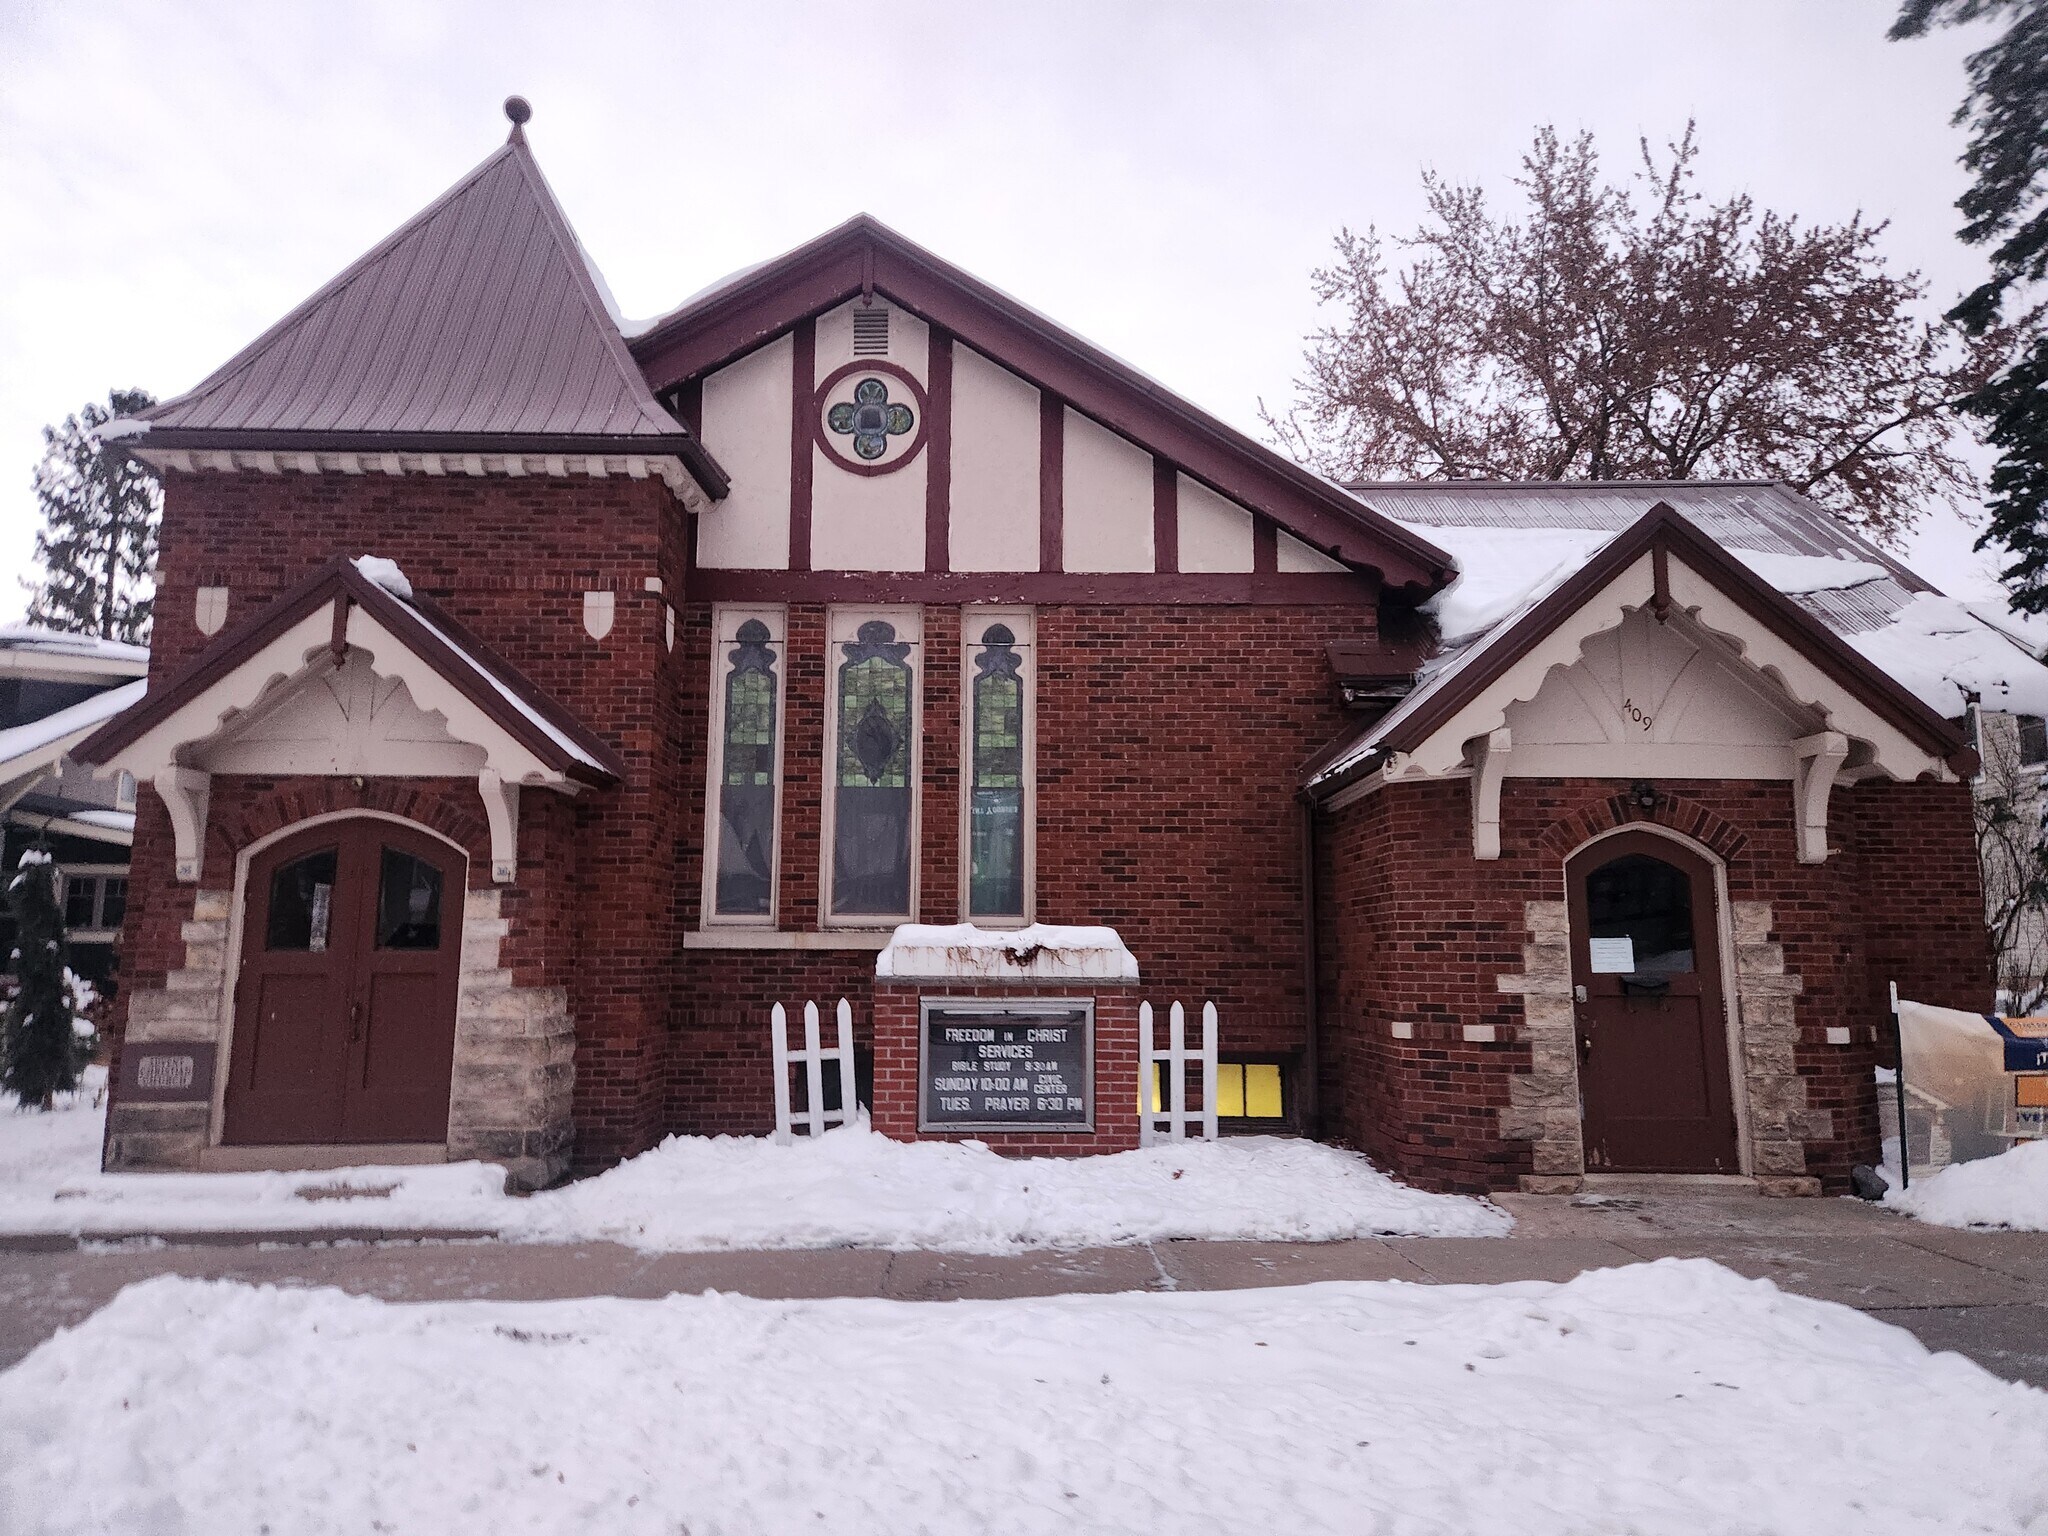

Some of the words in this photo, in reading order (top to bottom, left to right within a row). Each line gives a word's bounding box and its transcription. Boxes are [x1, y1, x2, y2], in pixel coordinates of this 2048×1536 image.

[1623, 698, 1653, 732] 409
[945, 1028, 995, 1042] FREEDOM
[1003, 1032, 1014, 1042] IN
[1027, 1028, 1068, 1043] CHRIST
[978, 1045, 1034, 1058] SERVICES
[951, 1061, 978, 1072] BIBLE
[983, 1061, 1011, 1072] STUDY
[934, 1077, 979, 1091] SUNDAY
[1012, 1077, 1029, 1091] AM
[1038, 1075, 1063, 1085] CIVIC
[1033, 1084, 1068, 1095] CENTER
[984, 1097, 1031, 1111] PRAYER
[1036, 1097, 1063, 1111] 6:30
[1066, 1097, 1083, 1111] PM
